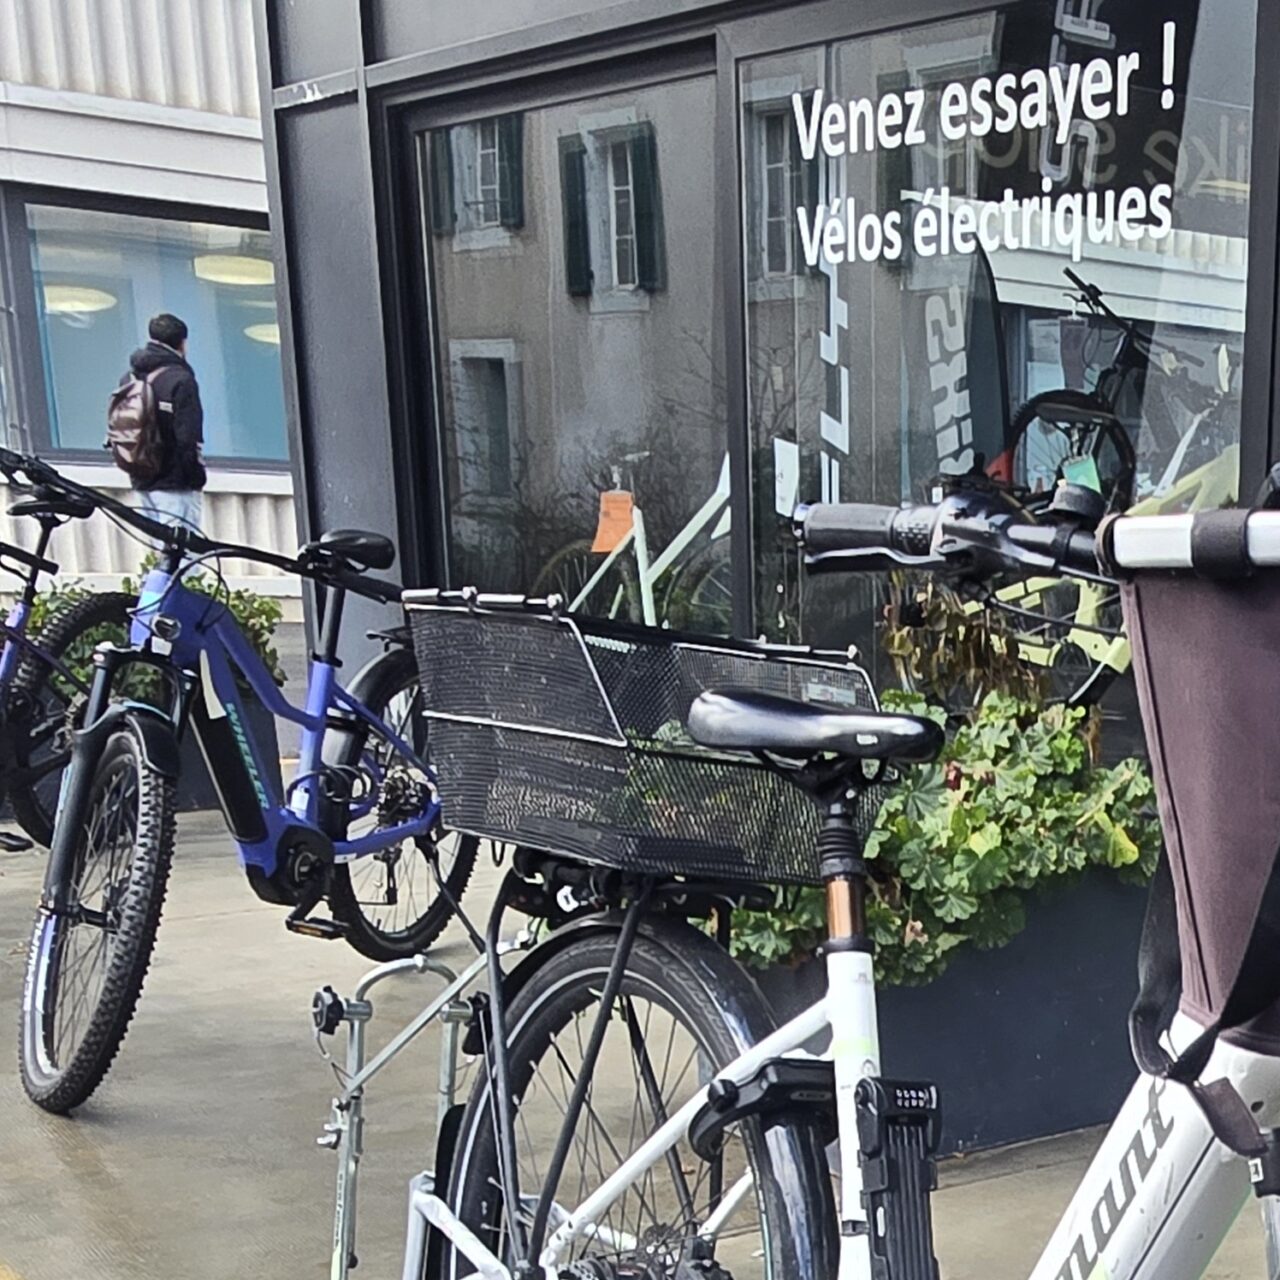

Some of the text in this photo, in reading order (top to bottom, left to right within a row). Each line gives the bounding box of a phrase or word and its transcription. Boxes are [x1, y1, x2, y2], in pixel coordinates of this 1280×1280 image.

[792, 21, 1176, 160] Venez essayer !
[797, 177, 1171, 266] Vélos électriques
